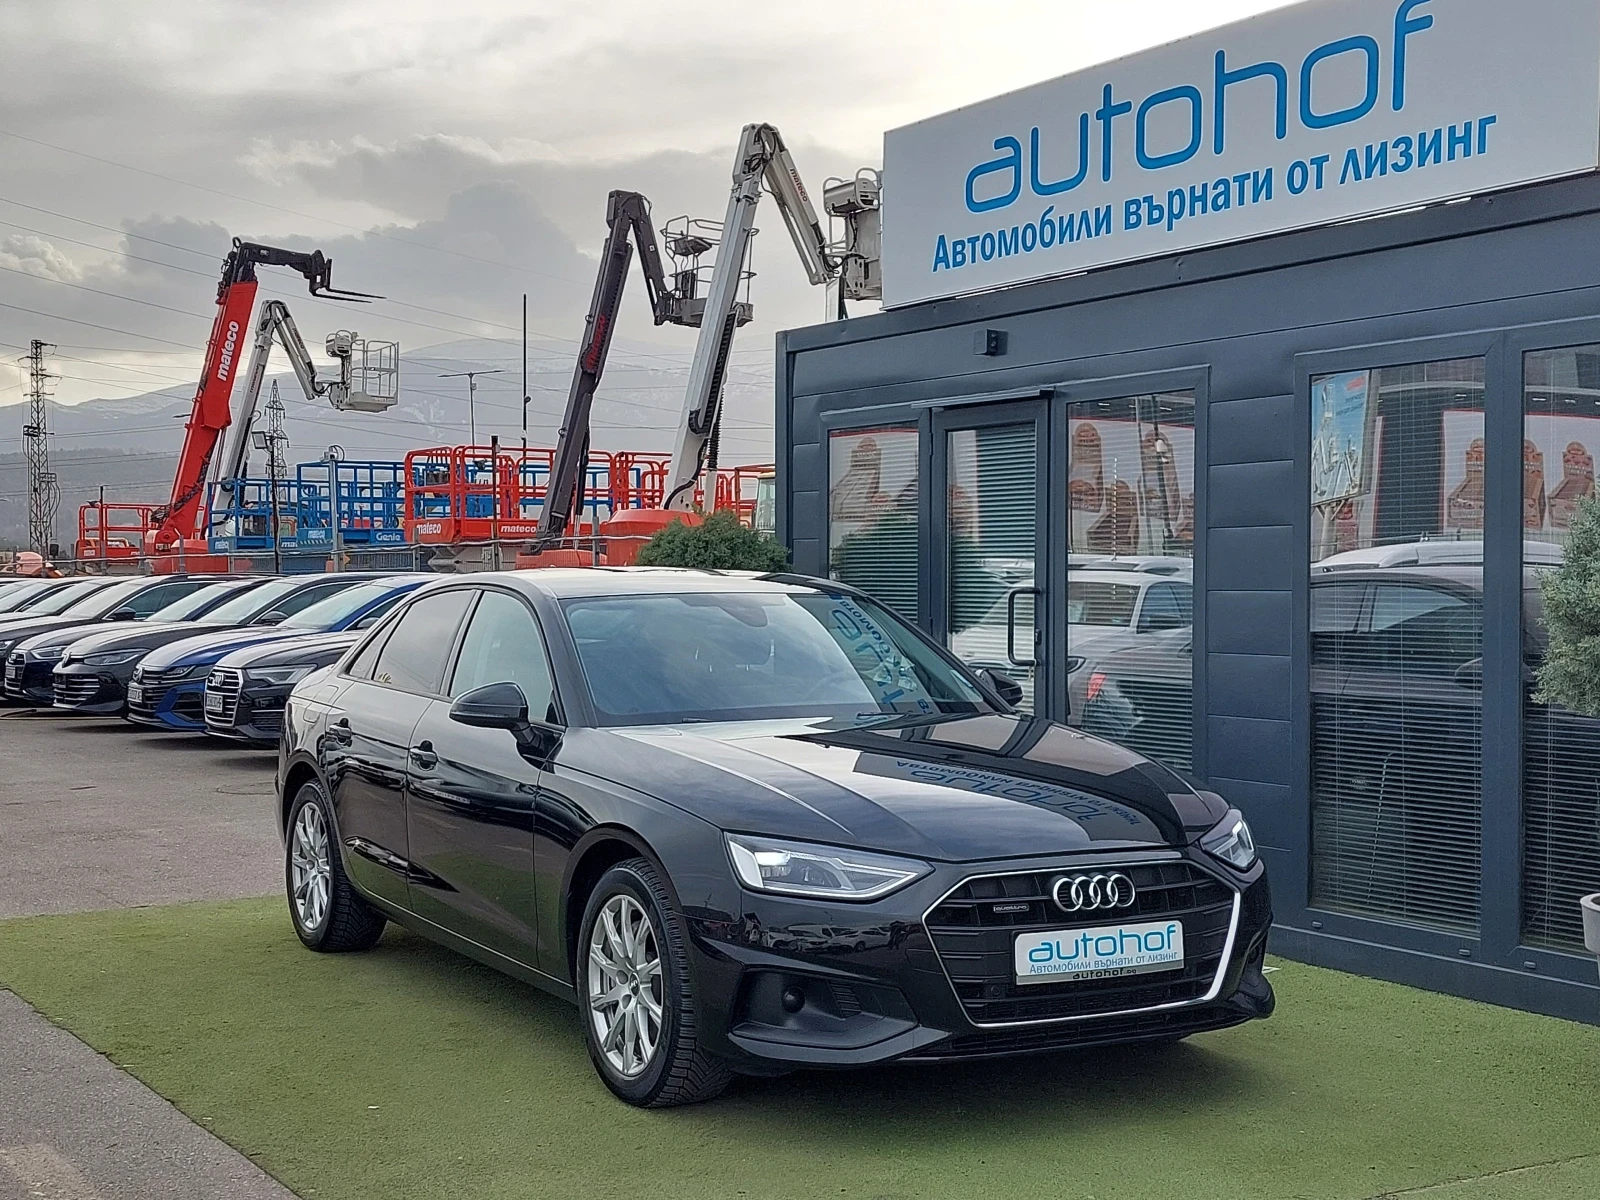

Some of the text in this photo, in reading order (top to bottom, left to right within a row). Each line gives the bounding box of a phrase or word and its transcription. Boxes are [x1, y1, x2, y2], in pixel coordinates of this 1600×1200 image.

[964, 0, 1434, 213] autohof
[790, 168, 808, 202] mateco
[931, 115, 1498, 273] Автомобили върнати от лизинг
[217, 321, 239, 381] mateco
[375, 532, 401, 541] Genie
[416, 522, 442, 535] mateco
[501, 524, 537, 533] mateco
[1028, 924, 1176, 963] autohof
[1029, 951, 1178, 974] Автомобили върнати от лизинг
